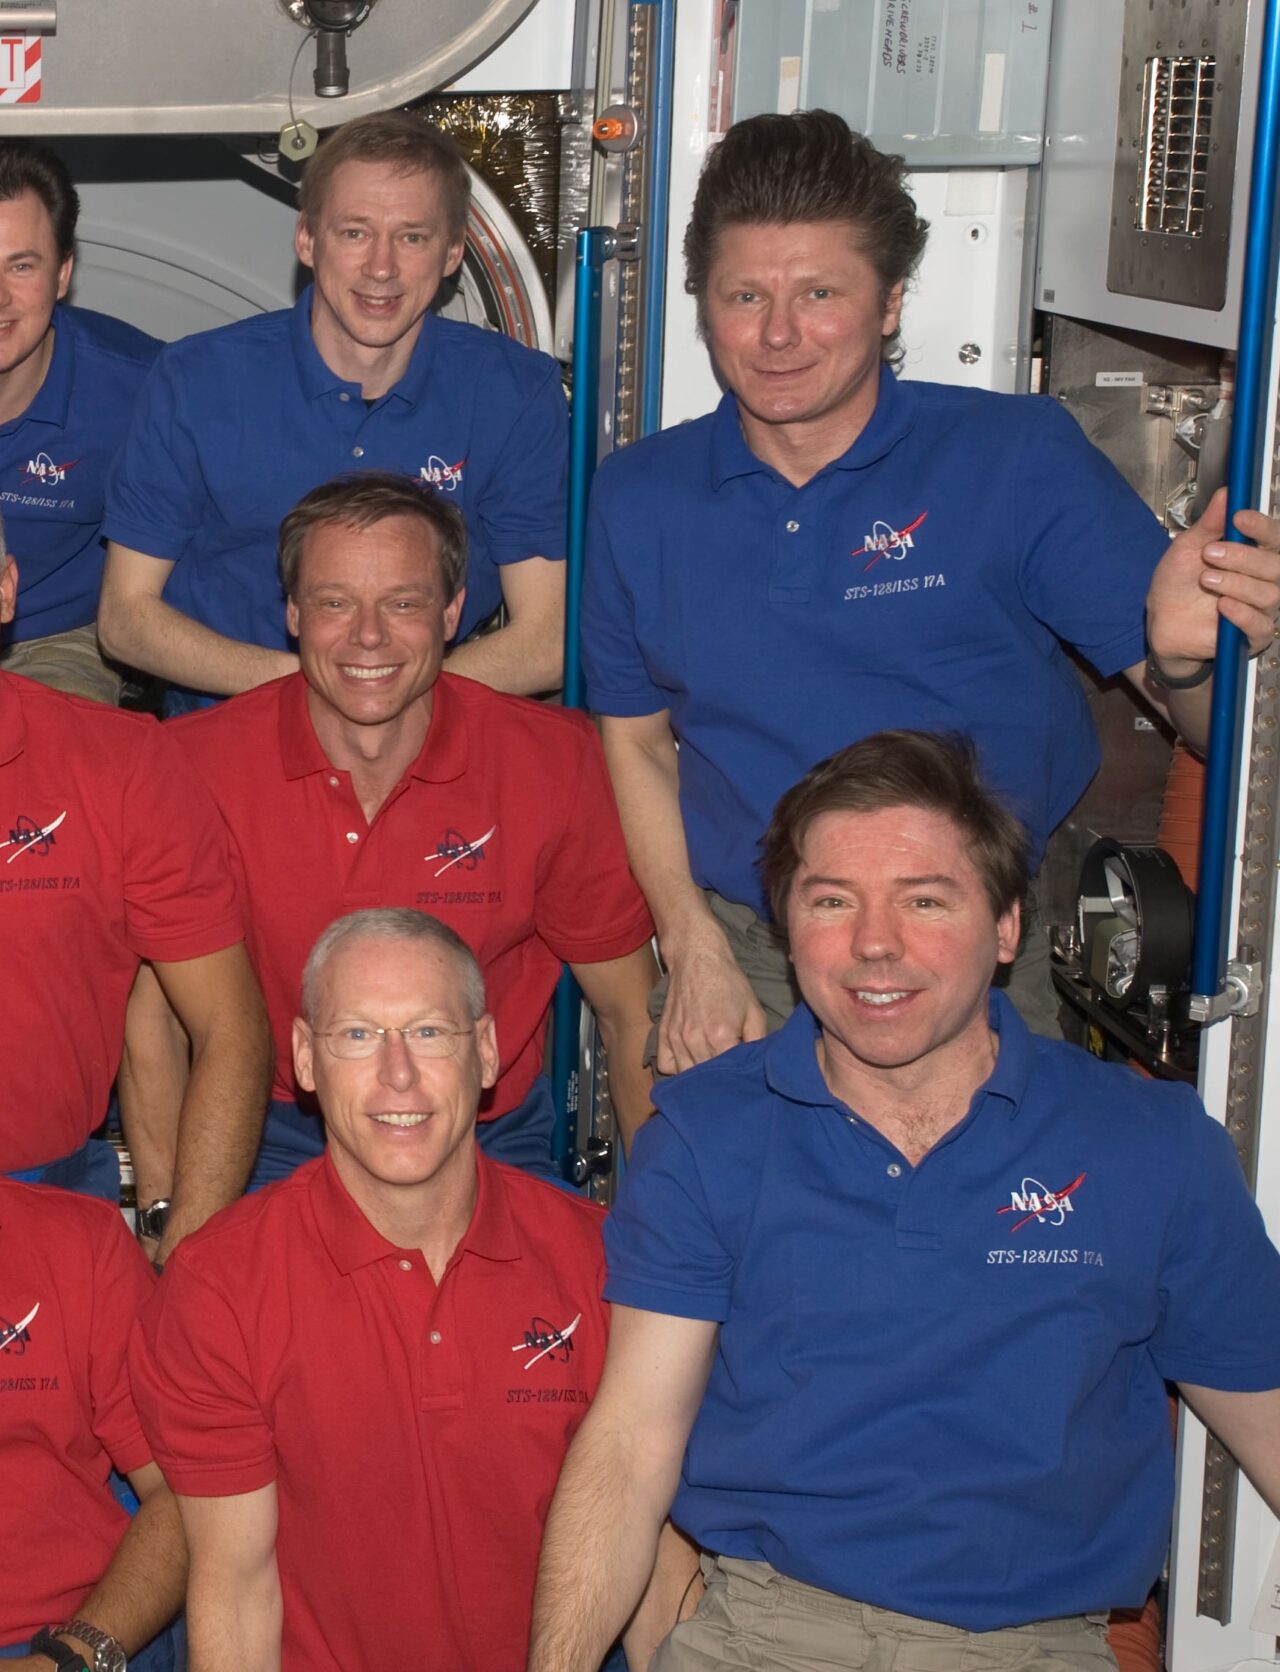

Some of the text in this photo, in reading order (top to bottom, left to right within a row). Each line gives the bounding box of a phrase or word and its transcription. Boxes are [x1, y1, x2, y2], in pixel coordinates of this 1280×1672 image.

[26, 459, 65, 481] NASA
[420, 466, 463, 482] NASA
[0, 491, 58, 508] STS-128/ISS
[864, 531, 914, 552] NASA
[844, 573, 946, 600] STS-128/ISS 17A
[8, 828, 56, 846] NASA
[436, 842, 486, 861] NASA
[60, 876, 80, 889] 17A
[1011, 1192, 1074, 1212] NASA
[987, 1250, 1104, 1267] STS-128/ISS 17A
[524, 1331, 574, 1352] NASA
[40, 1375, 60, 1391] 17A
[506, 1388, 577, 1403] STS-128/ISS
